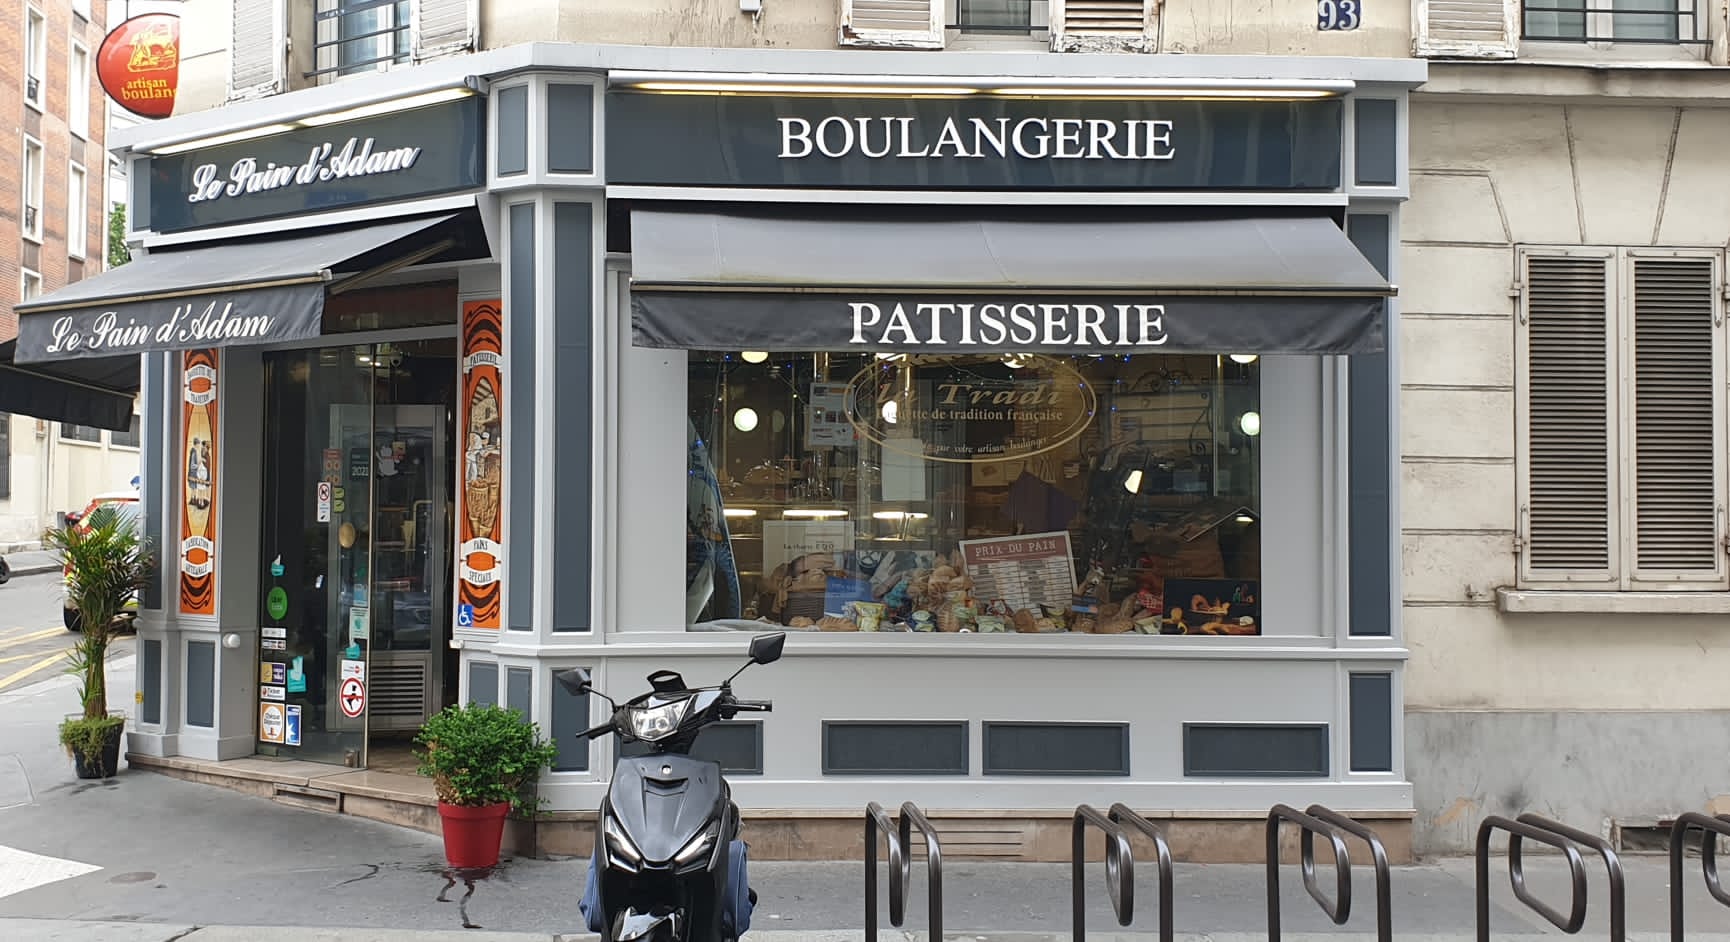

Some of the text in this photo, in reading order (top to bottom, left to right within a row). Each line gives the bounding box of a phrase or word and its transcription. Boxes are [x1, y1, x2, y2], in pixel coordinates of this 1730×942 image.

[1318, 0, 1358, 30] 93
[127, 77, 167, 89] artisan
[776, 116, 1176, 160] BOULANGERIE
[188, 137, 421, 203] Le Pain d'Adam
[46, 300, 275, 353] Le Pain d'Adam
[847, 301, 1169, 346] PATISSERIE
[931, 409, 948, 420] de
[949, 408, 1005, 420] tradition
[1007, 408, 1063, 423] française
[975, 540, 1056, 557] PRIX DU PAIN
